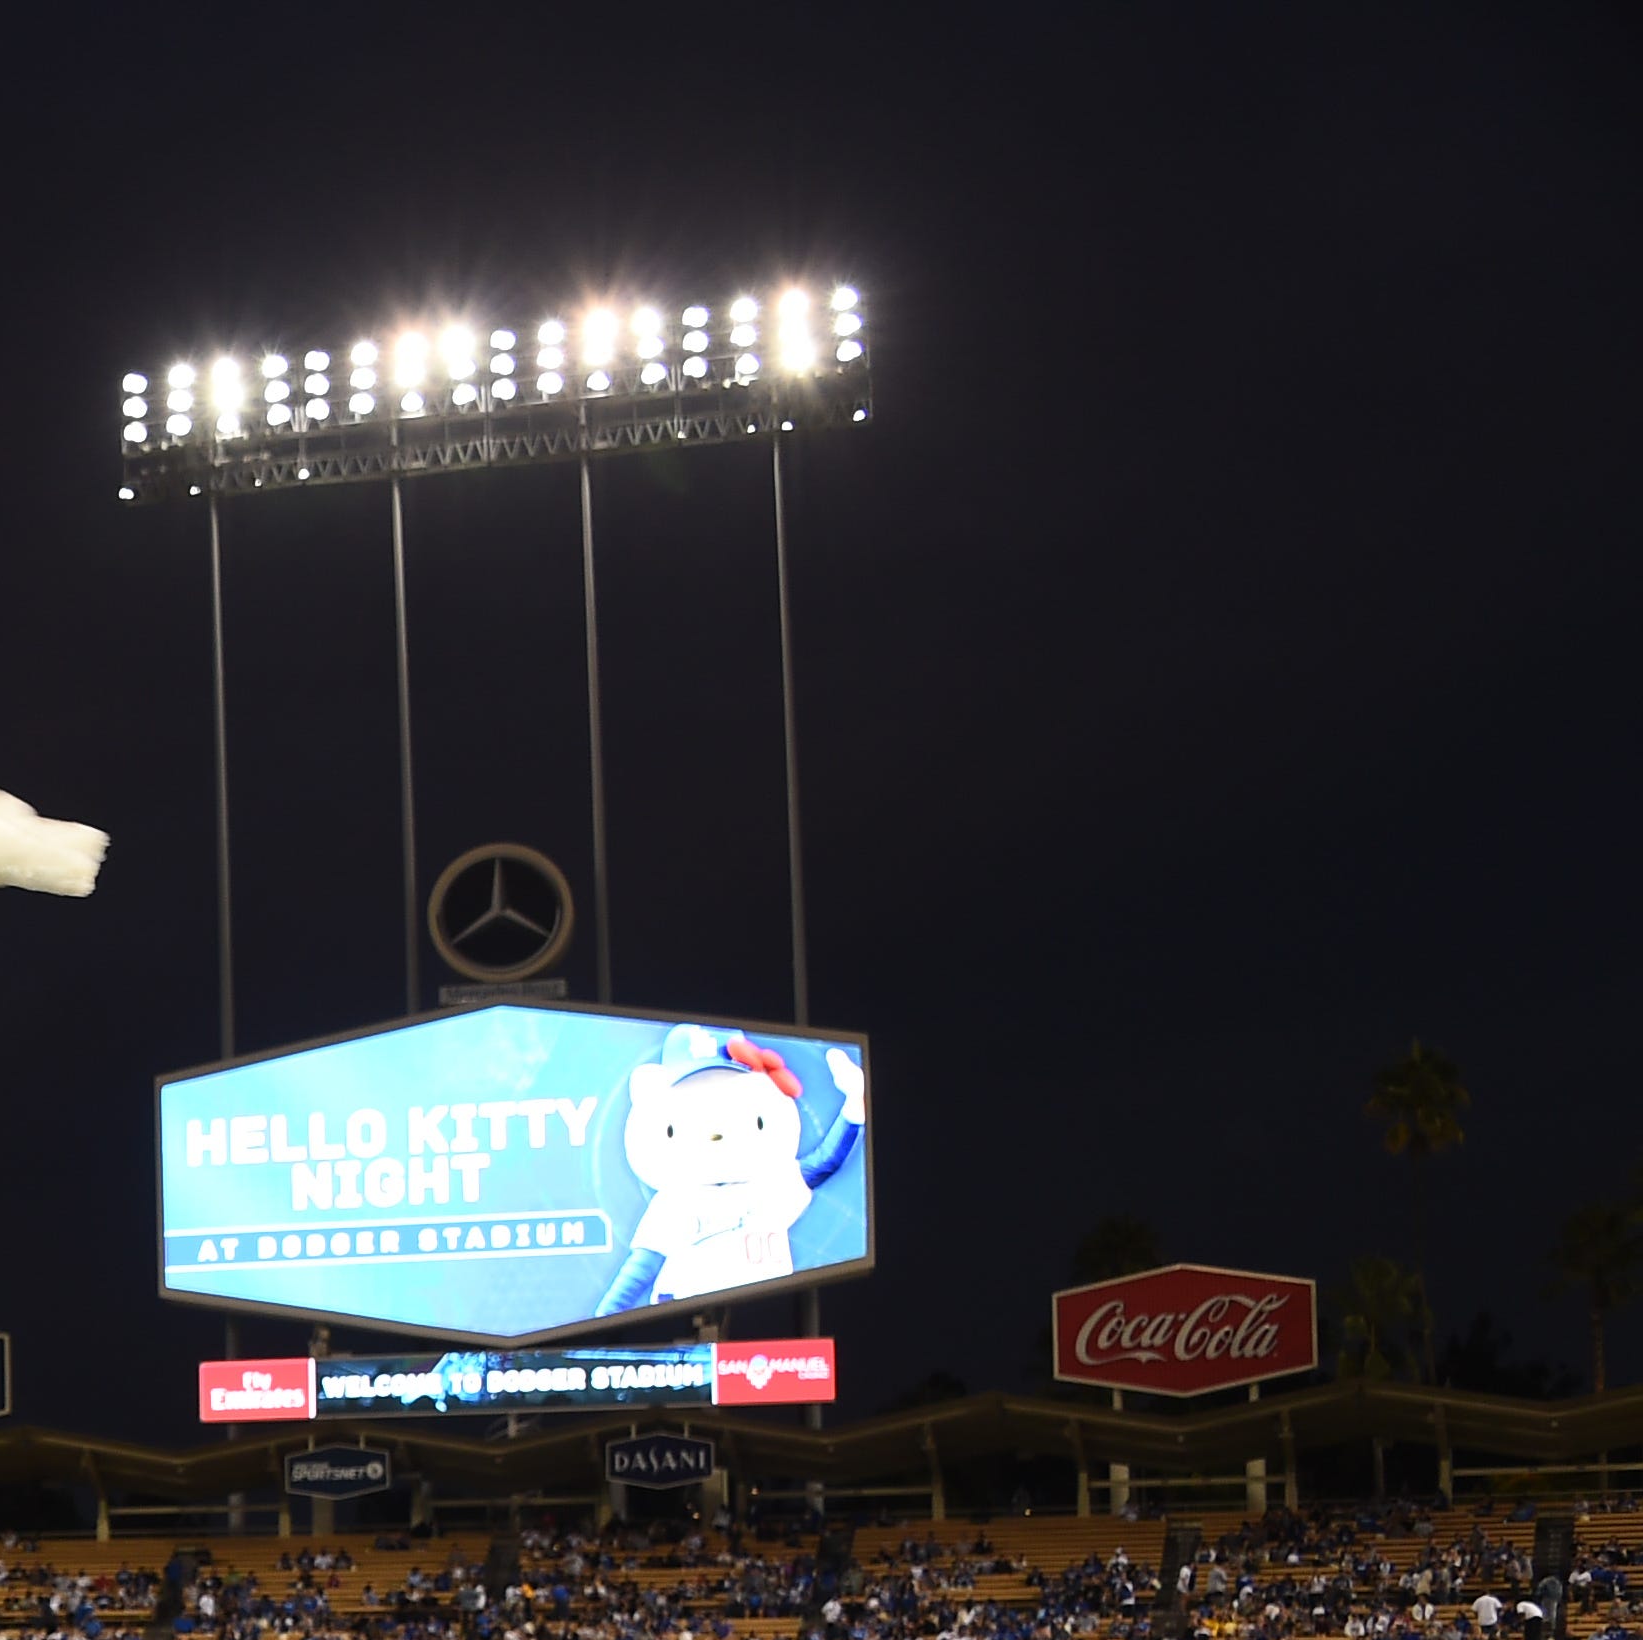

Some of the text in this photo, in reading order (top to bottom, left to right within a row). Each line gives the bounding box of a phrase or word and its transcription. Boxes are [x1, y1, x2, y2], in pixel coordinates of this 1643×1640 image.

[186, 1096, 598, 1167] HELLO KITTY
[290, 1152, 491, 1211] NIGHT
[197, 1237, 239, 1263] AT
[614, 1447, 706, 1476] DASANI
